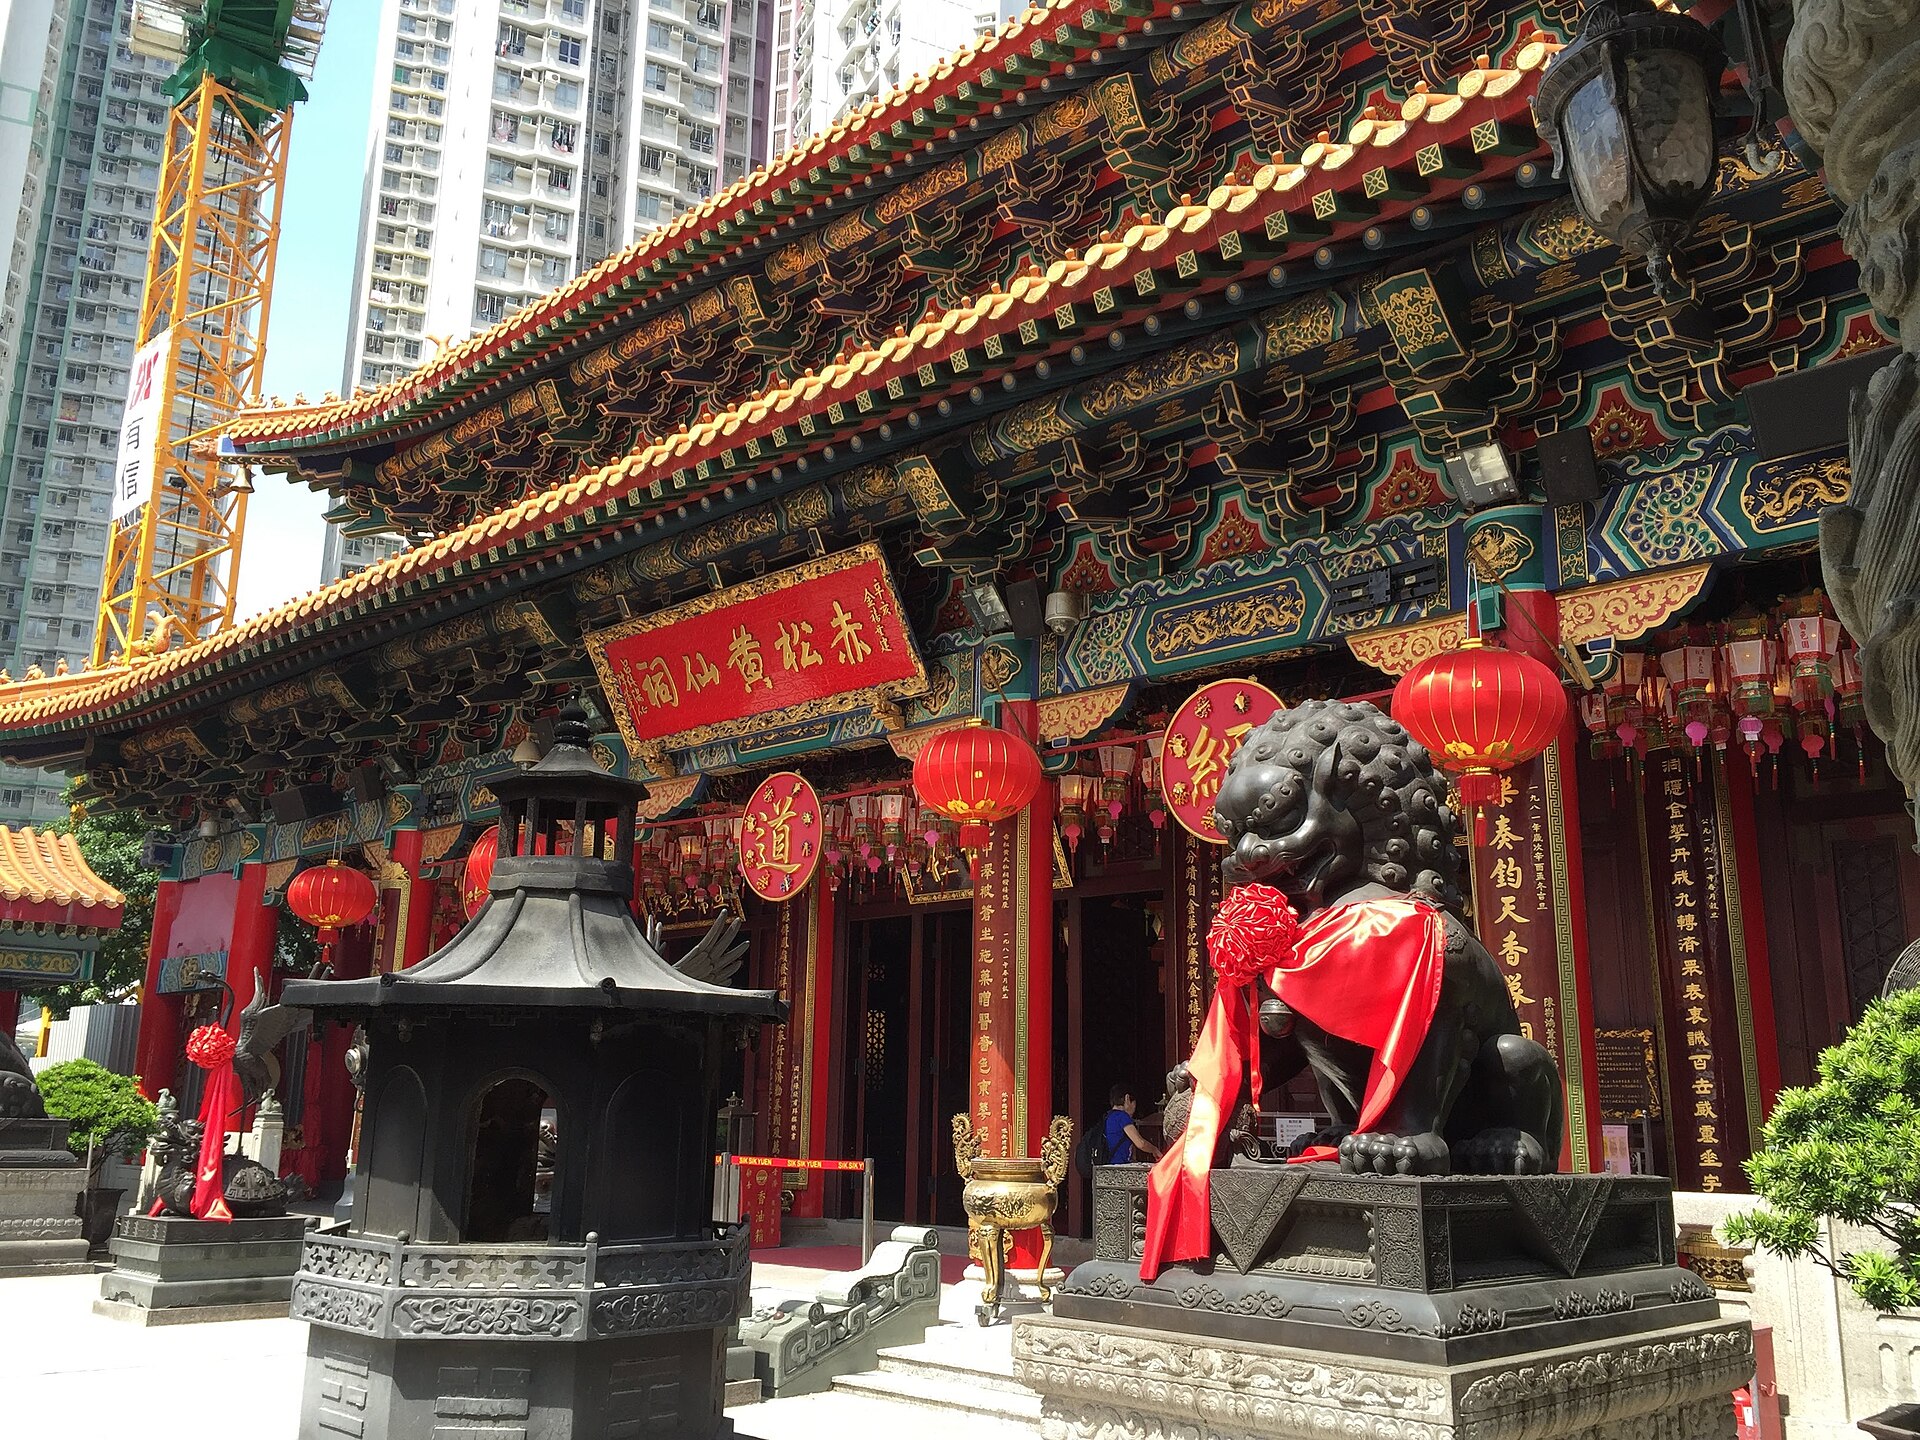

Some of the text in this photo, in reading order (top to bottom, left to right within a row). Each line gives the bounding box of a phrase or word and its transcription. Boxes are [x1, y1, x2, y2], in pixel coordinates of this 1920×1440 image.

[873, 578, 892, 616] 辛亥
[635, 600, 873, 709] 赤松黃仙祠
[754, 796, 802, 874] 道
[739, 1157, 748, 1165] SIK
[757, 1158, 772, 1166] YUEN
[796, 1160, 806, 1168] SIK
